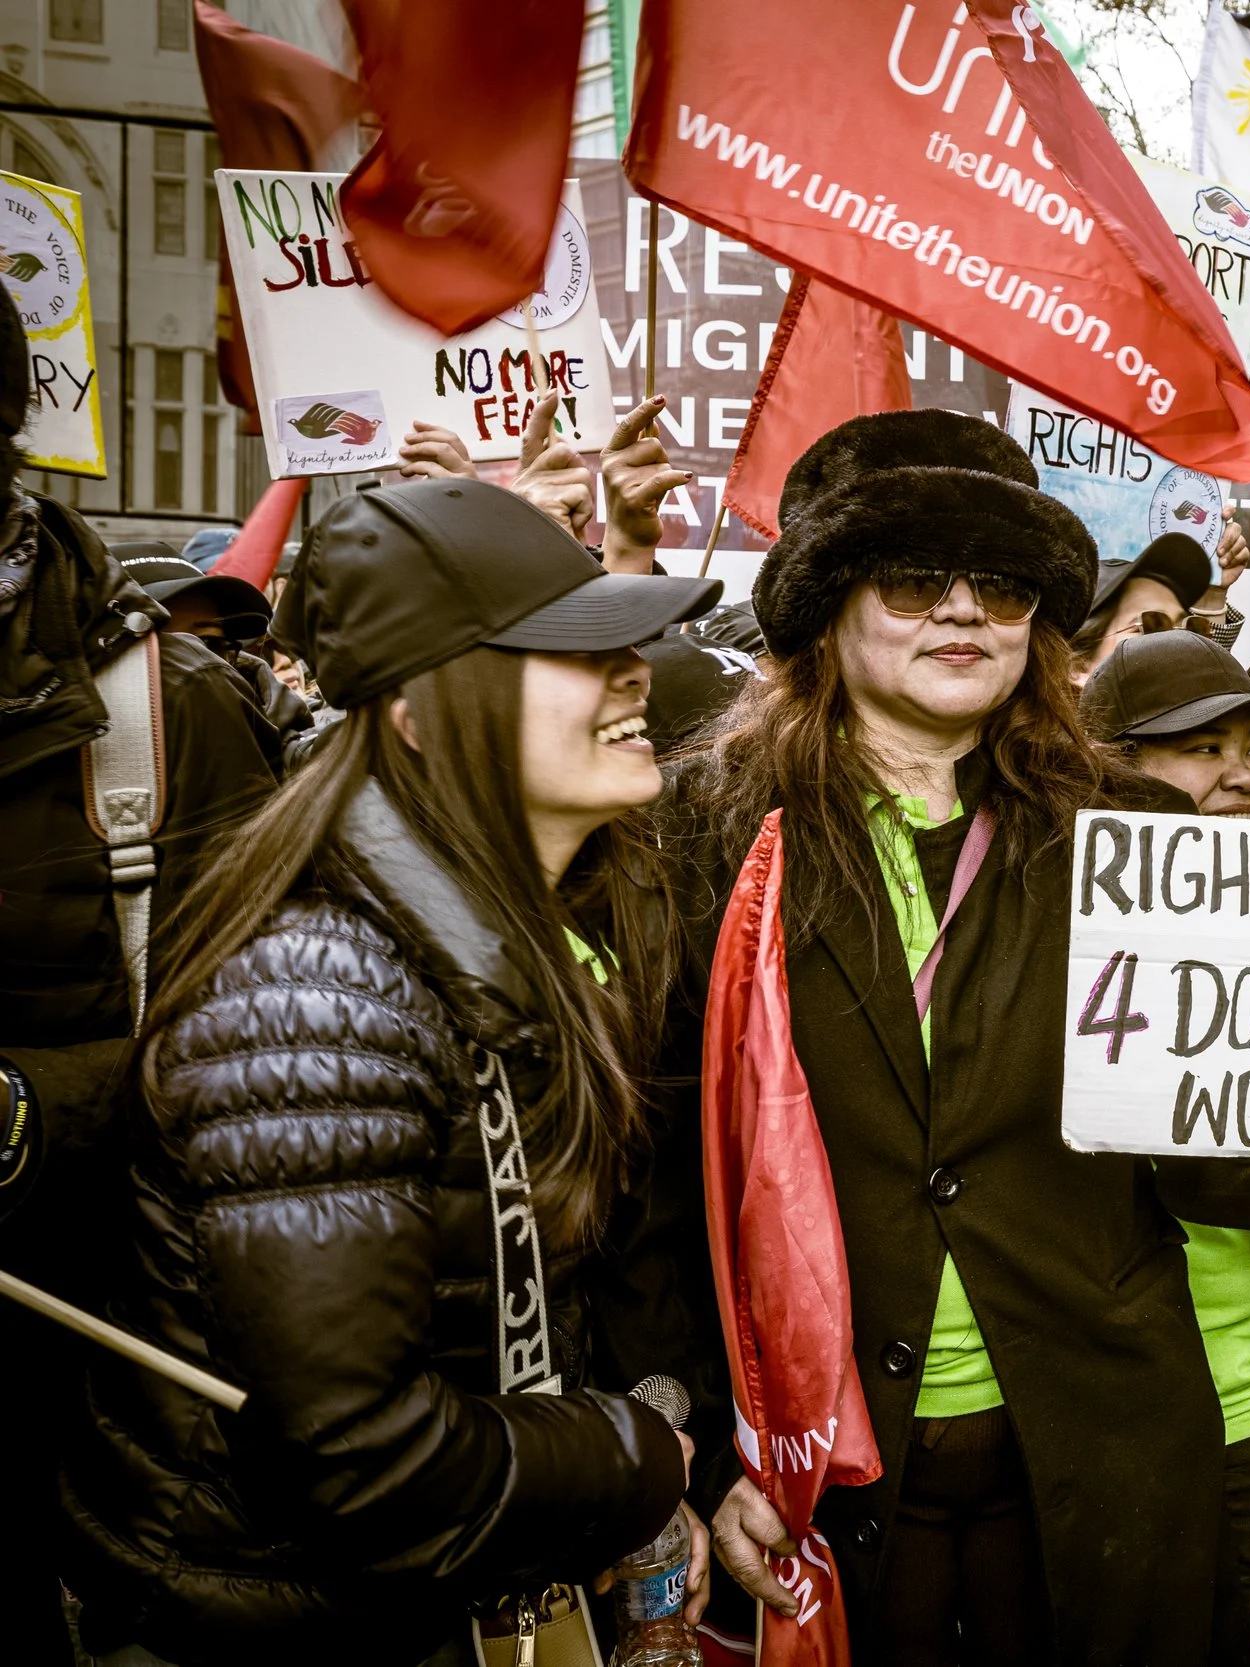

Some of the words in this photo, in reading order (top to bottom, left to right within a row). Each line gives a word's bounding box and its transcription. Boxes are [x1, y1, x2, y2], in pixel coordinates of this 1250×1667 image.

[4, 198, 37, 225] THE
[233, 178, 302, 249] NO
[46, 231, 70, 285] VOICE
[562, 230, 582, 307] DOMESTIC
[677, 104, 1176, 417] www.unitetheunion.org
[48, 295, 65, 316] OF
[435, 348, 493, 396] NO
[287, 450, 336, 470] dignity
[340, 449, 355, 463] at
[357, 446, 394, 462] work
[1167, 478, 1178, 493] OF
[1077, 949, 1150, 1065] 4
[8, 1100, 28, 1146] NOTHING
